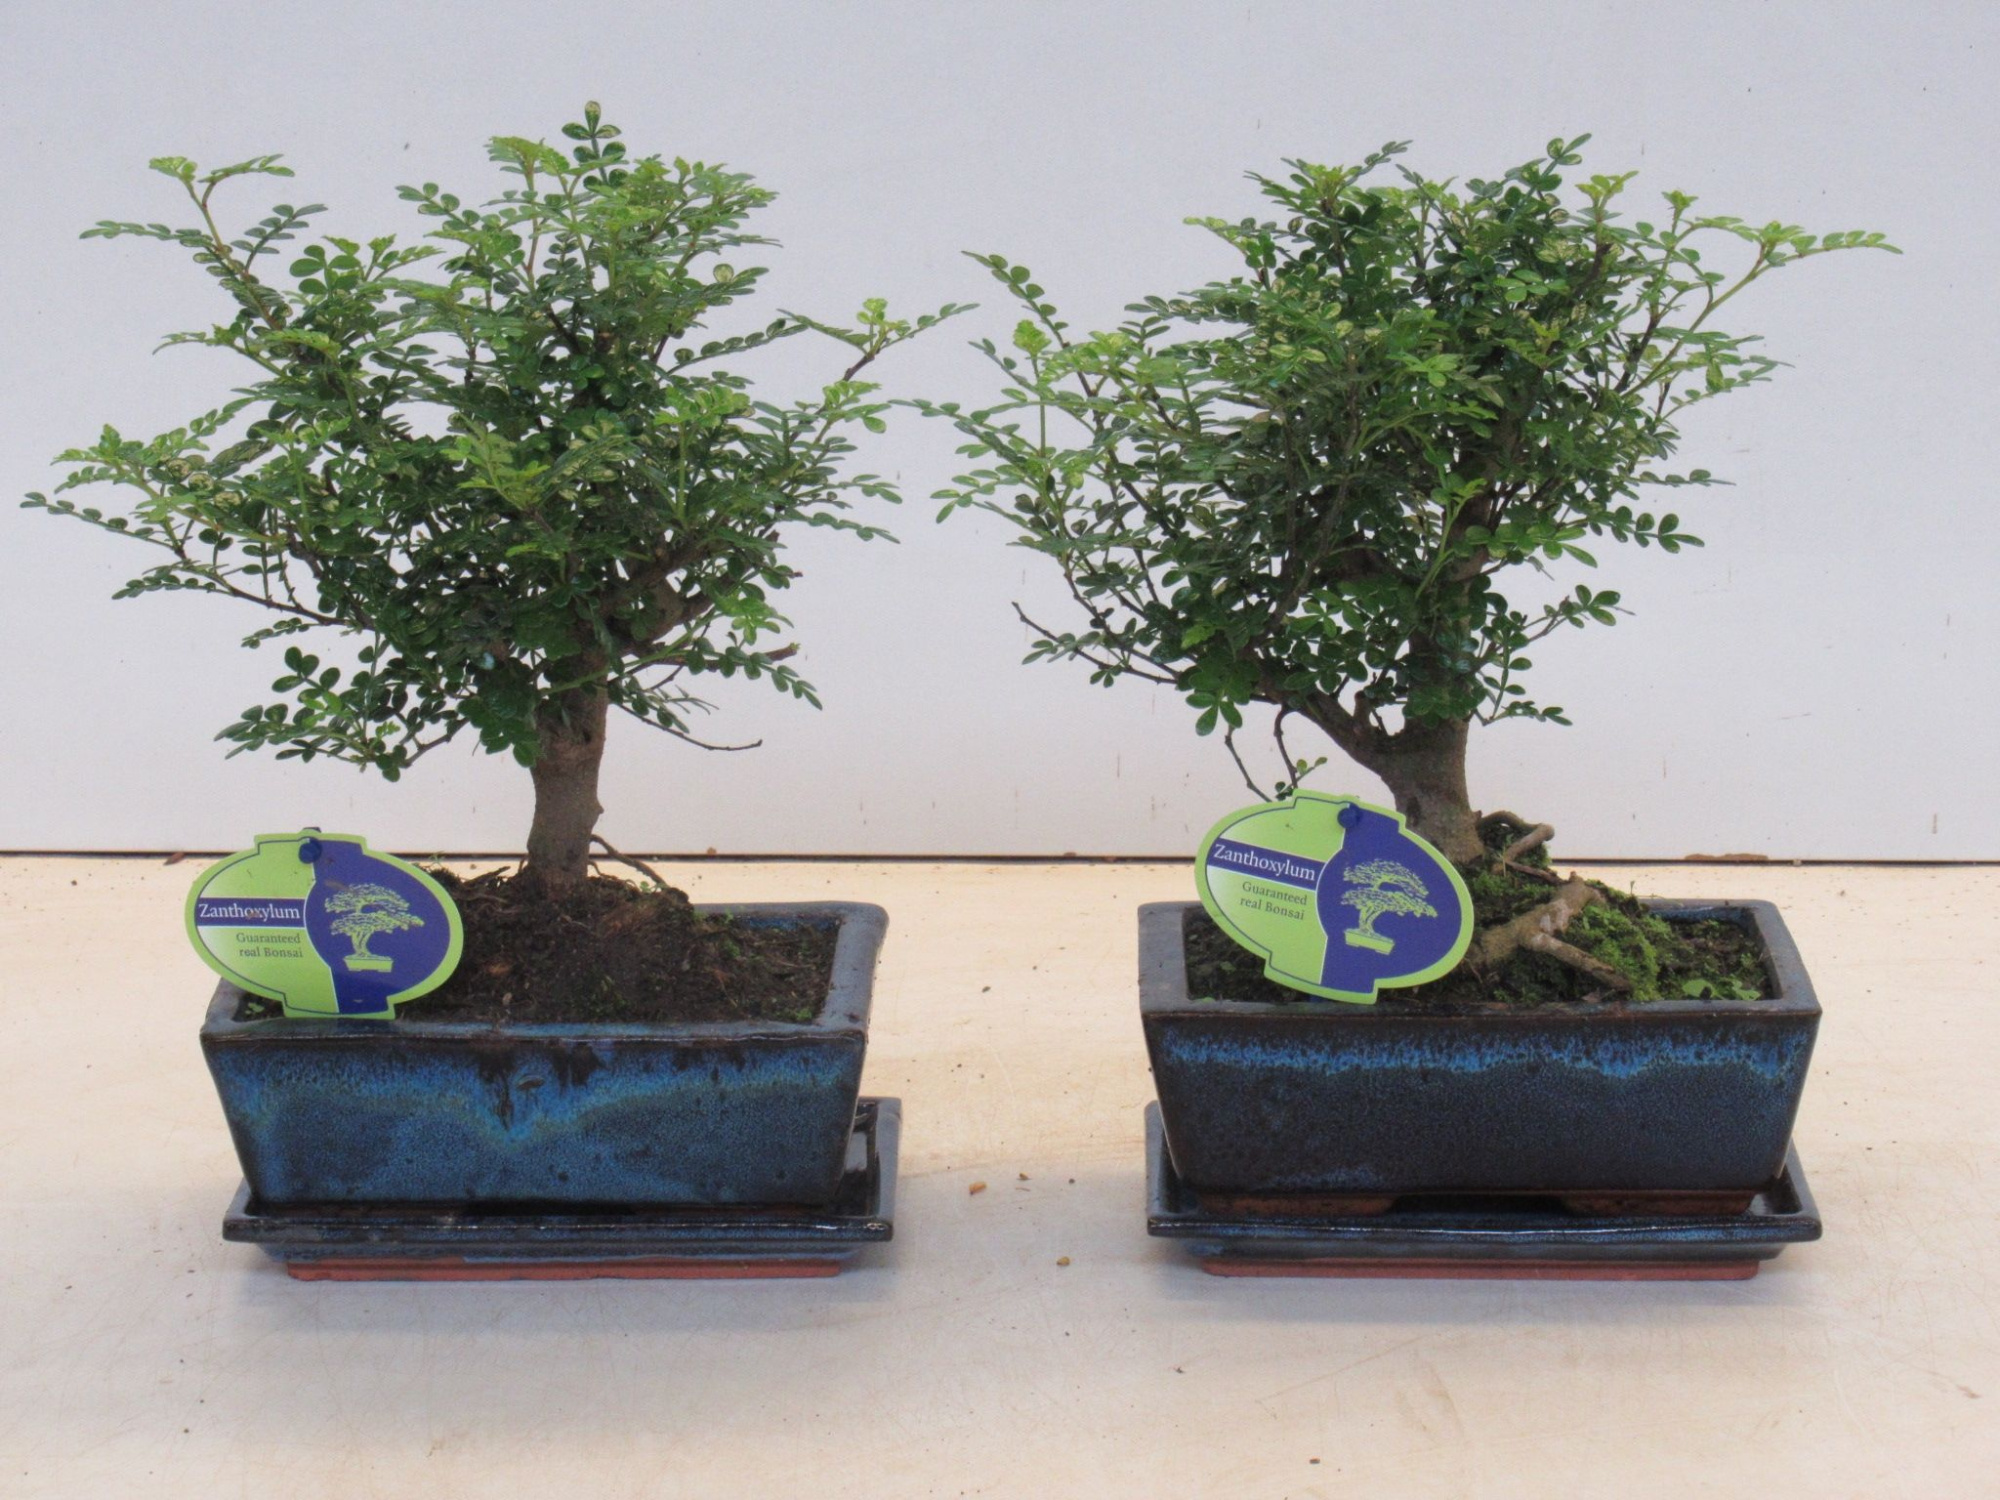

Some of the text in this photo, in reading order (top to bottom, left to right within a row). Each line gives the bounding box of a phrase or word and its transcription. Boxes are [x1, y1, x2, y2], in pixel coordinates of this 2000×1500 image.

[1213, 843, 1316, 881] Zanthoxylum
[1242, 881, 1308, 906] Guaranteed
[199, 903, 300, 922] Zanthoxylum
[1240, 897, 1305, 920] real Bonsai
[236, 932, 301, 944] Guaranteed
[240, 946, 303, 958] real Bonsai
